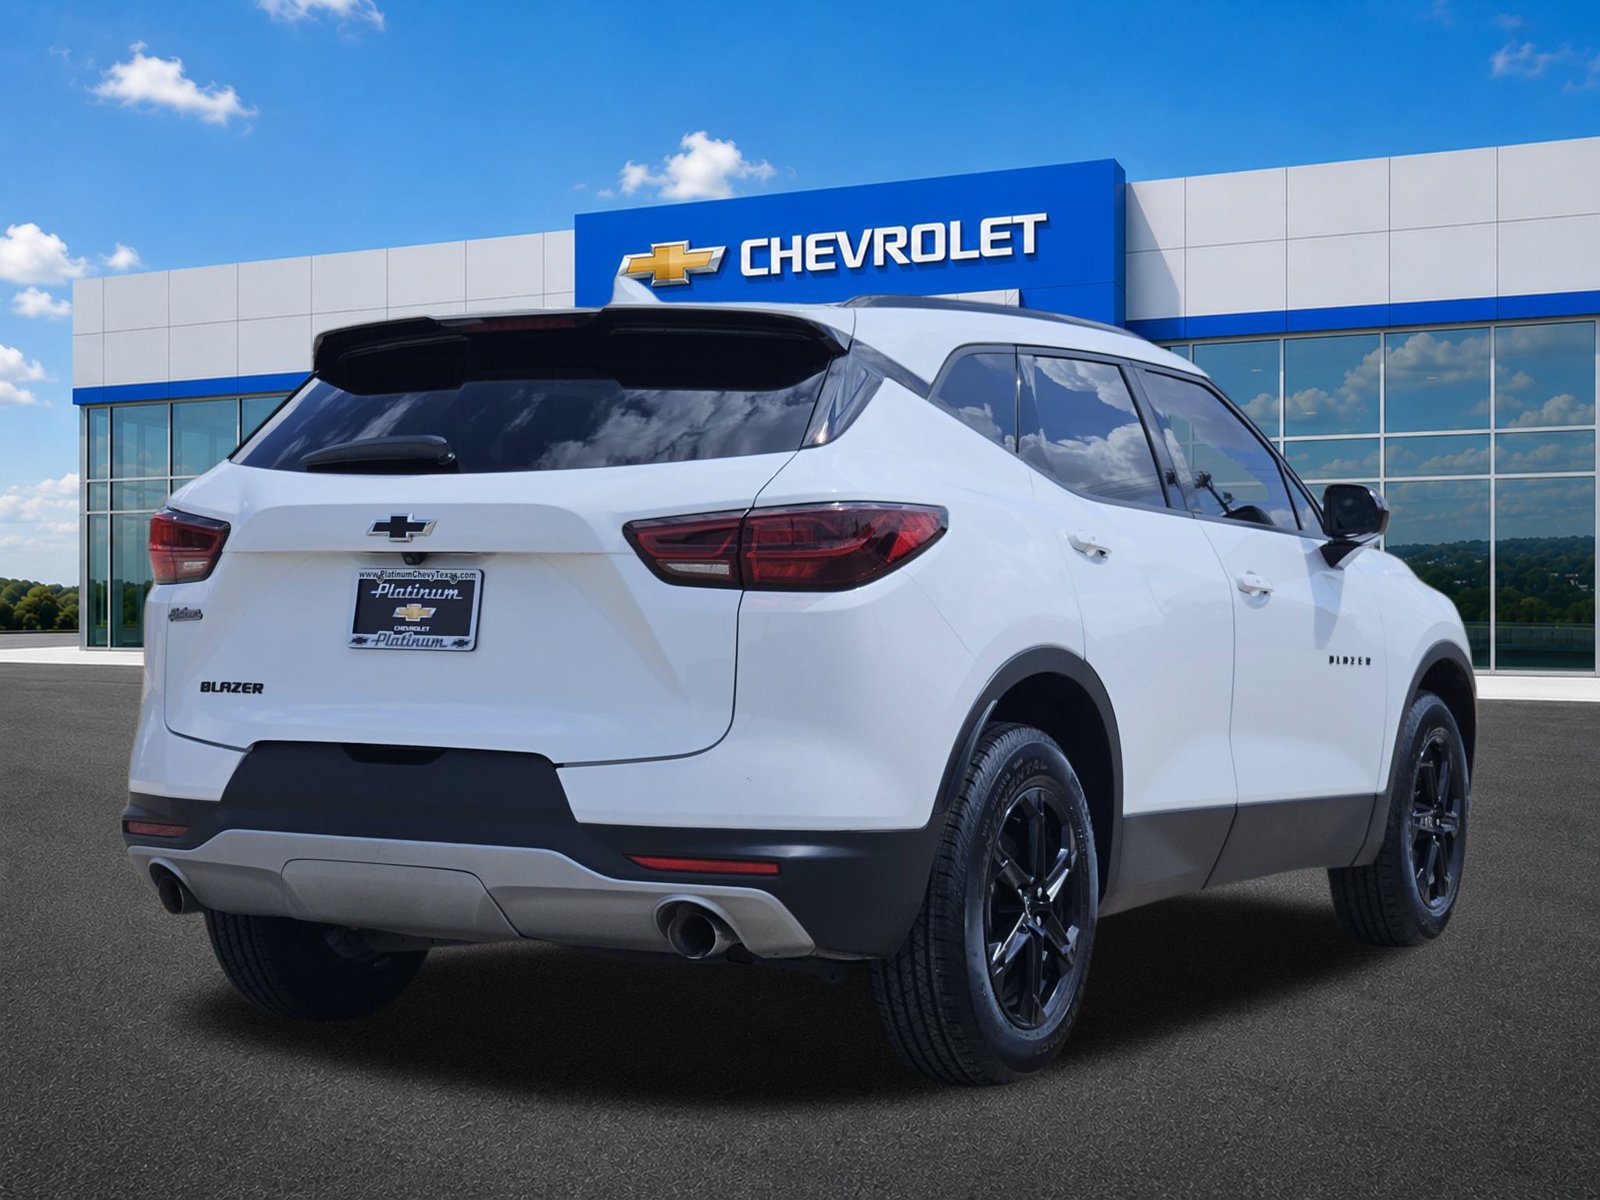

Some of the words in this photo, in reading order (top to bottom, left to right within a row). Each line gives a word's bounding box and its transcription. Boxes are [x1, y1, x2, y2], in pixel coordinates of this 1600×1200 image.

[740, 212, 1048, 277] CHEVROLET
[358, 570, 476, 581] wwwPlatinumChevyTexas.com
[370, 583, 463, 600] Platinum
[370, 632, 448, 649] Platinum
[1328, 655, 1371, 666] BLAZER
[200, 681, 264, 694] BLAZER
